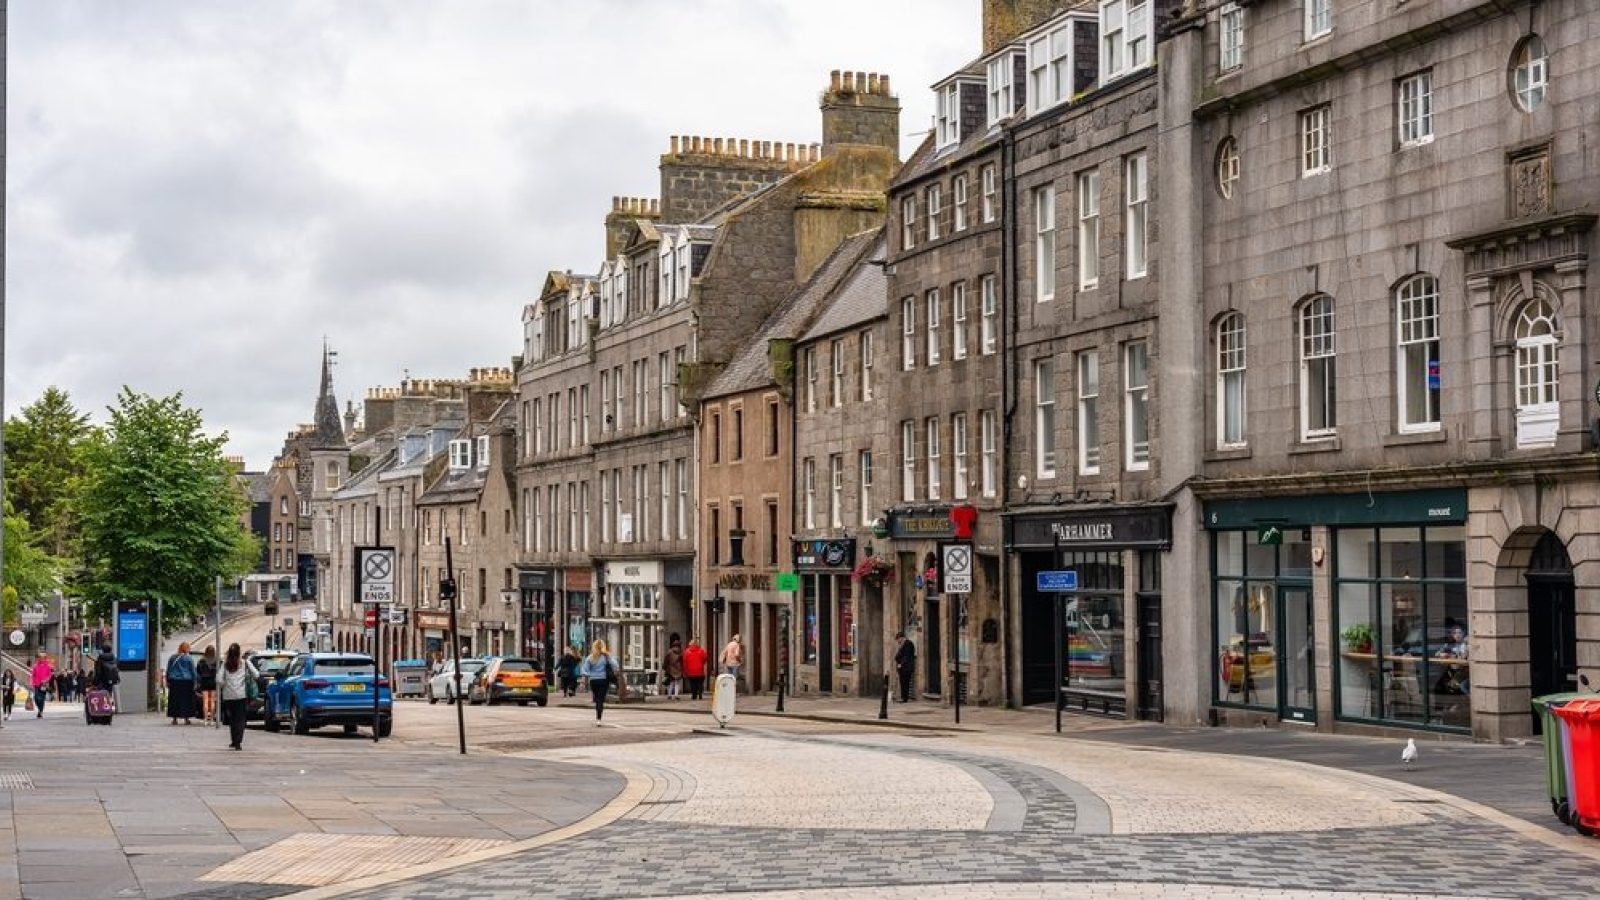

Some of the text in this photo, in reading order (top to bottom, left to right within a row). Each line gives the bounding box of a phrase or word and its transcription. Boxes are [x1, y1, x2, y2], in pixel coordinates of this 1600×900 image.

[1428, 507, 1450, 516] mount
[1211, 512, 1218, 524] 6
[1051, 522, 1113, 540] WARHAMMER
[365, 592, 390, 600] ENDS
